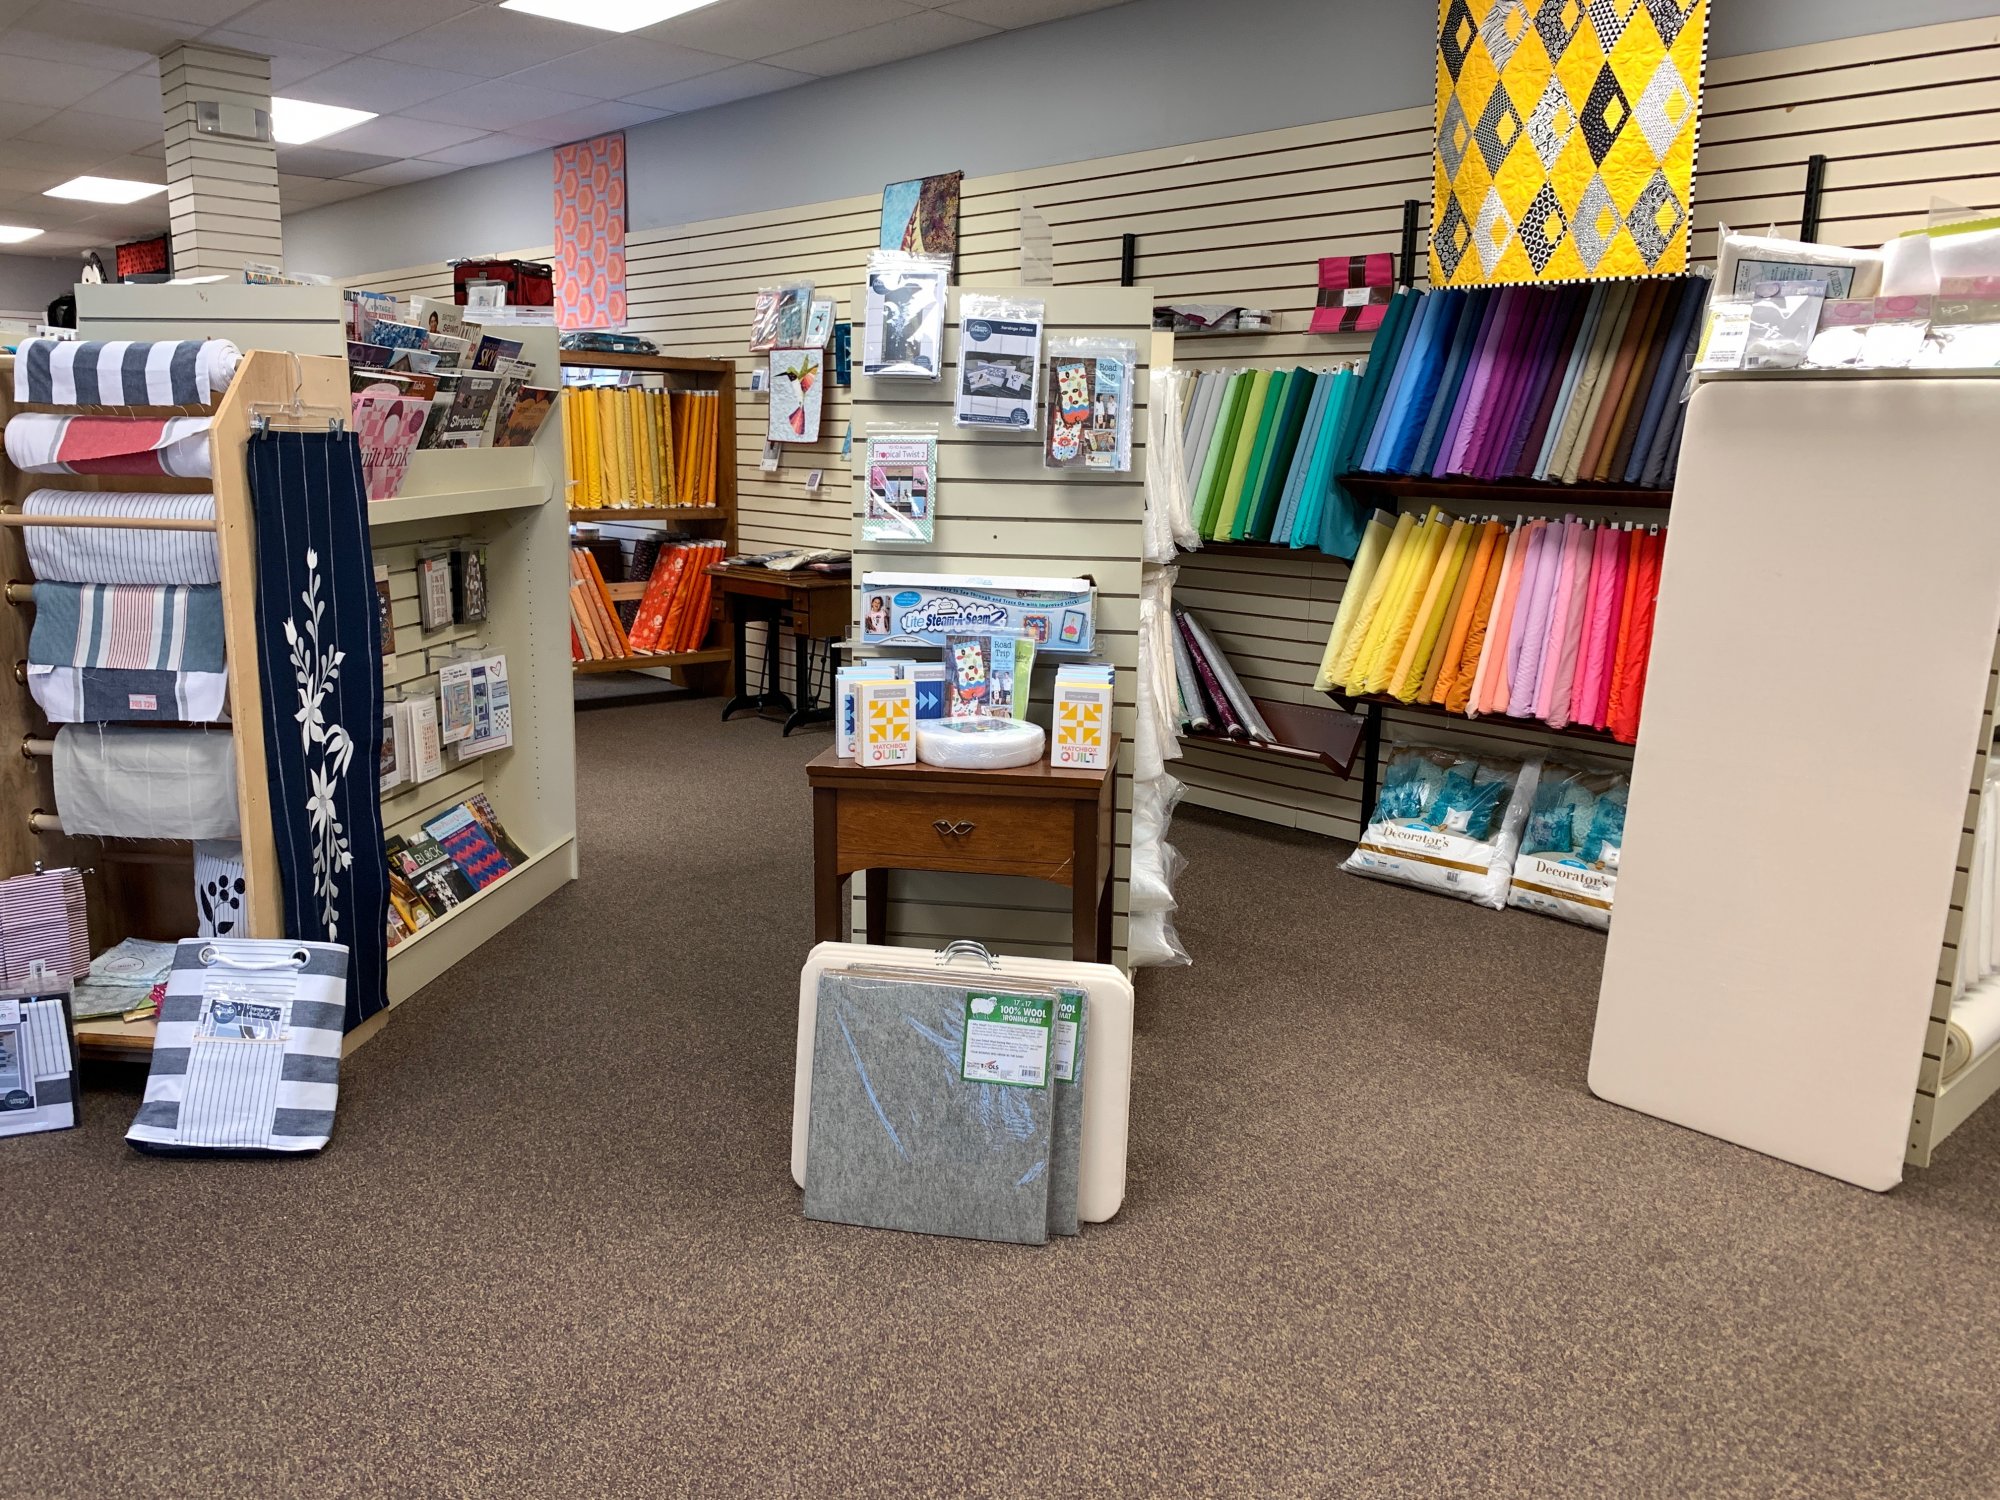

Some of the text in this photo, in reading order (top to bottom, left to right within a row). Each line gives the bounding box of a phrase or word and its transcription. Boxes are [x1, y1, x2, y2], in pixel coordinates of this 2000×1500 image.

[442, 324, 459, 334] sewn
[413, 381, 426, 390] Table
[875, 450, 901, 459] Tropical
[970, 591, 991, 601] Through
[905, 616, 925, 627] Lite
[991, 610, 1004, 626] 2
[995, 650, 1010, 658] Trip
[872, 749, 908, 760] QUILT
[1061, 752, 1098, 763] QUILT
[1384, 825, 1450, 847] Decorator's
[414, 844, 443, 865] BLOCK
[1536, 861, 1609, 888] Decorator's
[1000, 1006, 1046, 1018] 100% WOOL
[1058, 1004, 1076, 1013] OOL
[1003, 1014, 1028, 1023] IRONING
